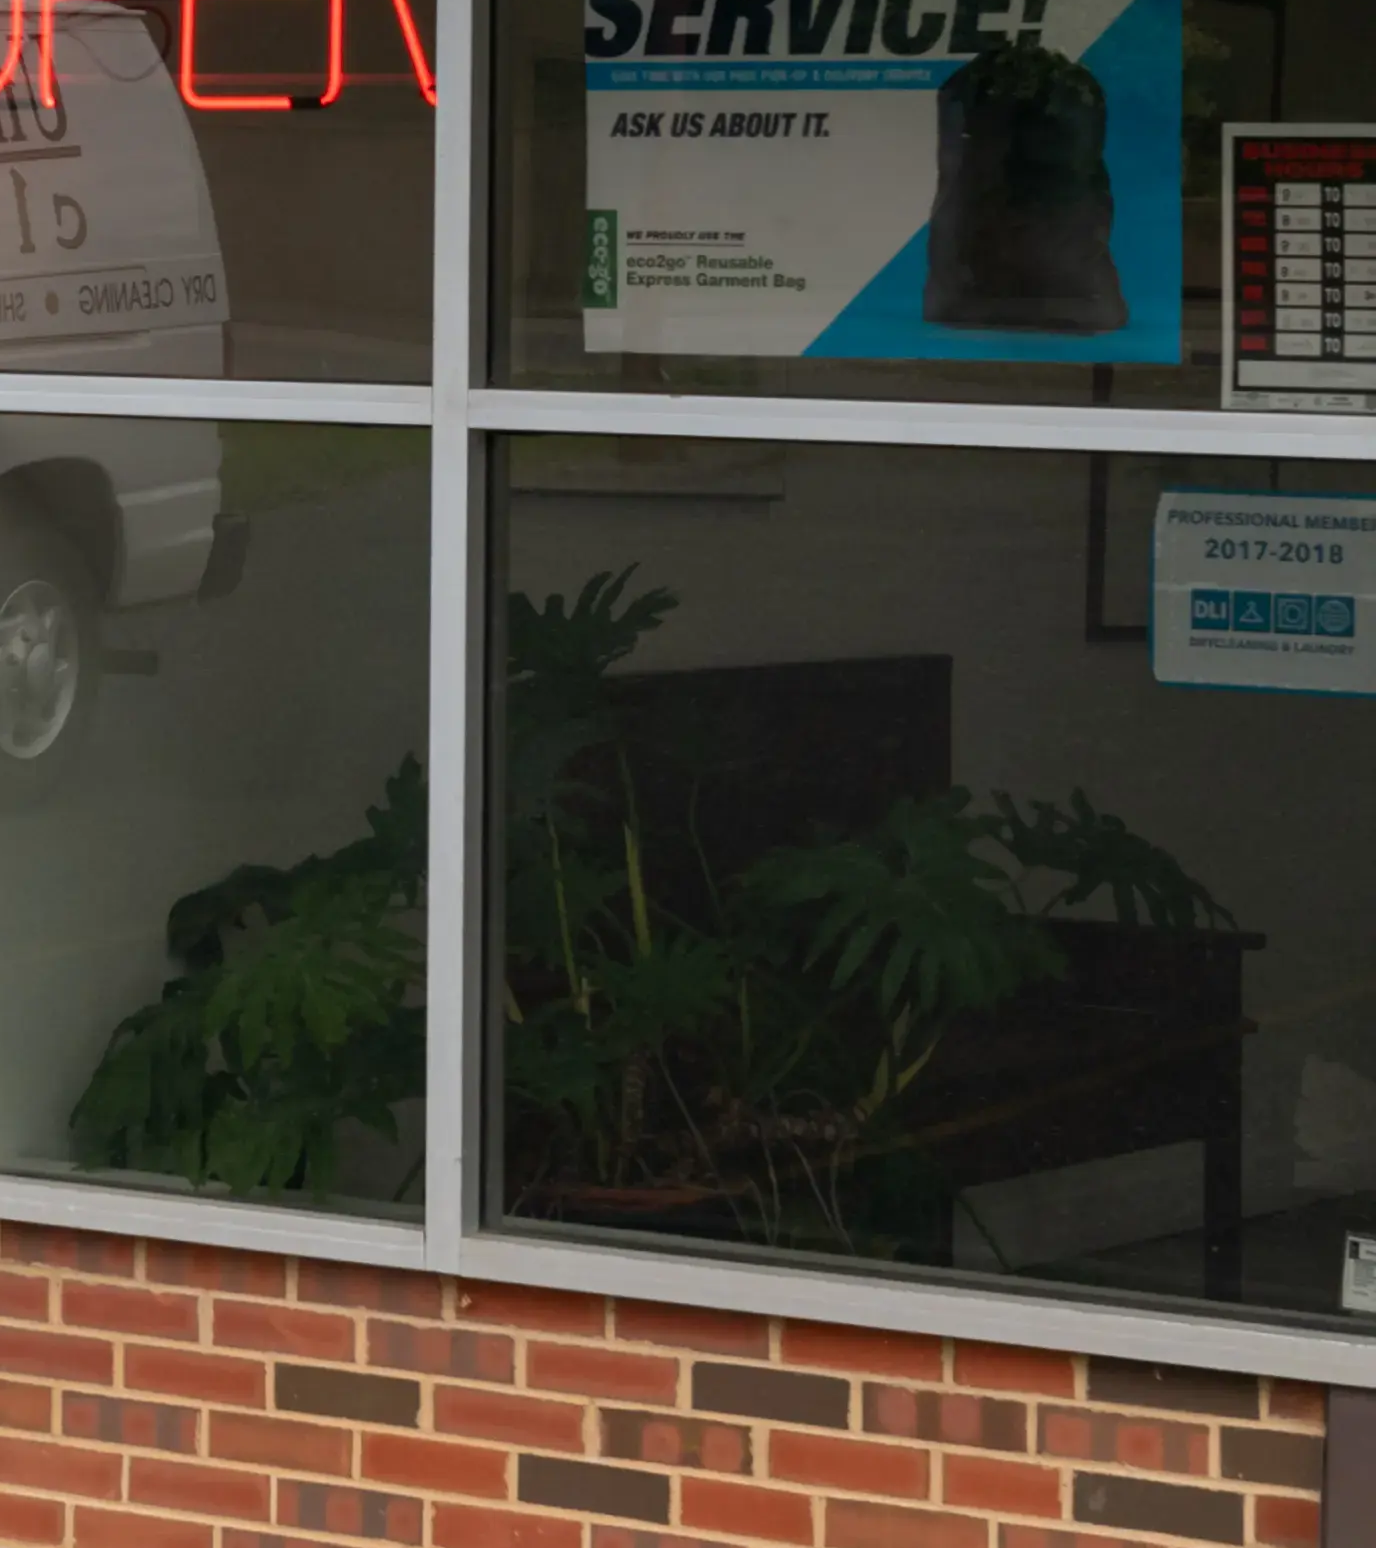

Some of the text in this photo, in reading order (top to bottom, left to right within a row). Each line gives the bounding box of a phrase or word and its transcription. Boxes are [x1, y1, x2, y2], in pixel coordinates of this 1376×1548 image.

[610, 111, 830, 138] ASK US ABOUT IT.
[1324, 187, 1341, 202] TO
[1324, 212, 1341, 227] TO
[1324, 237, 1341, 252] TO
[696, 254, 774, 270] Reusable
[1324, 262, 1341, 278] TO
[626, 271, 807, 291] Express Garment Bag
[1324, 288, 1341, 303] TO
[1324, 312, 1341, 328] TO
[1324, 338, 1341, 353] TO
[1168, 509, 1376, 532] PROFESSIONAL MEMBE
[1204, 537, 1344, 564] 2017-2018
[1194, 599, 1227, 620] DLI
